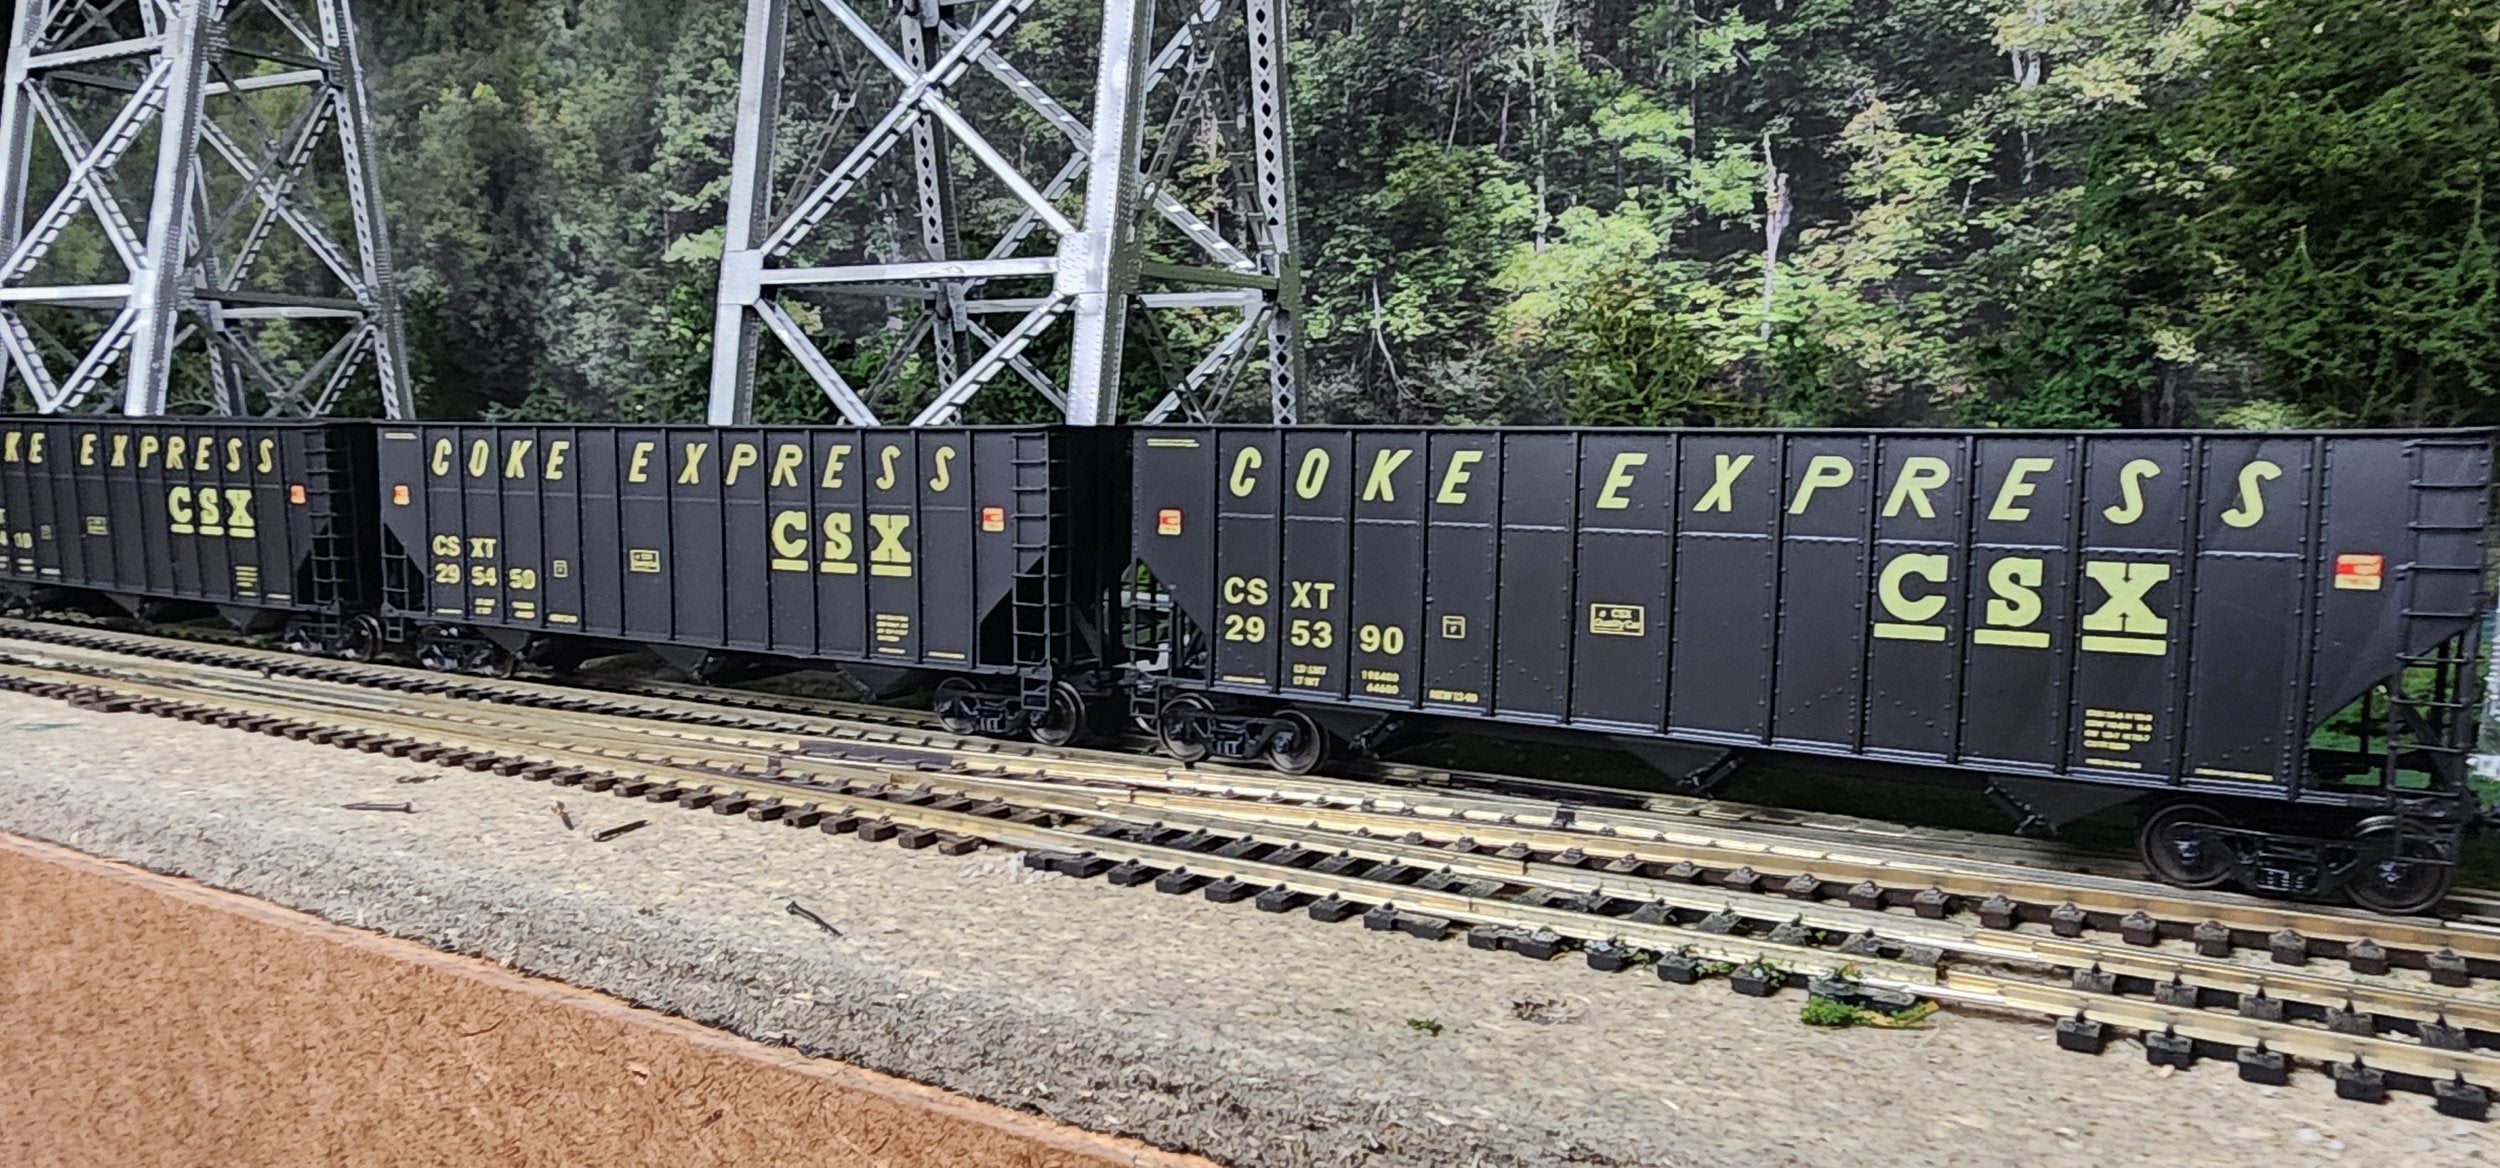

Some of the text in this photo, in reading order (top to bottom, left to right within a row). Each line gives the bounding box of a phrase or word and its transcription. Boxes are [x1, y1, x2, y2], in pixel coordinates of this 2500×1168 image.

[80, 433, 274, 473] EXPRESS
[431, 438, 957, 492] COKE EXPRESS
[168, 486, 255, 528] CSX
[1228, 446, 2281, 528] COKE EXPRESS
[771, 510, 912, 564] CSX
[1878, 552, 2171, 635] CSX
